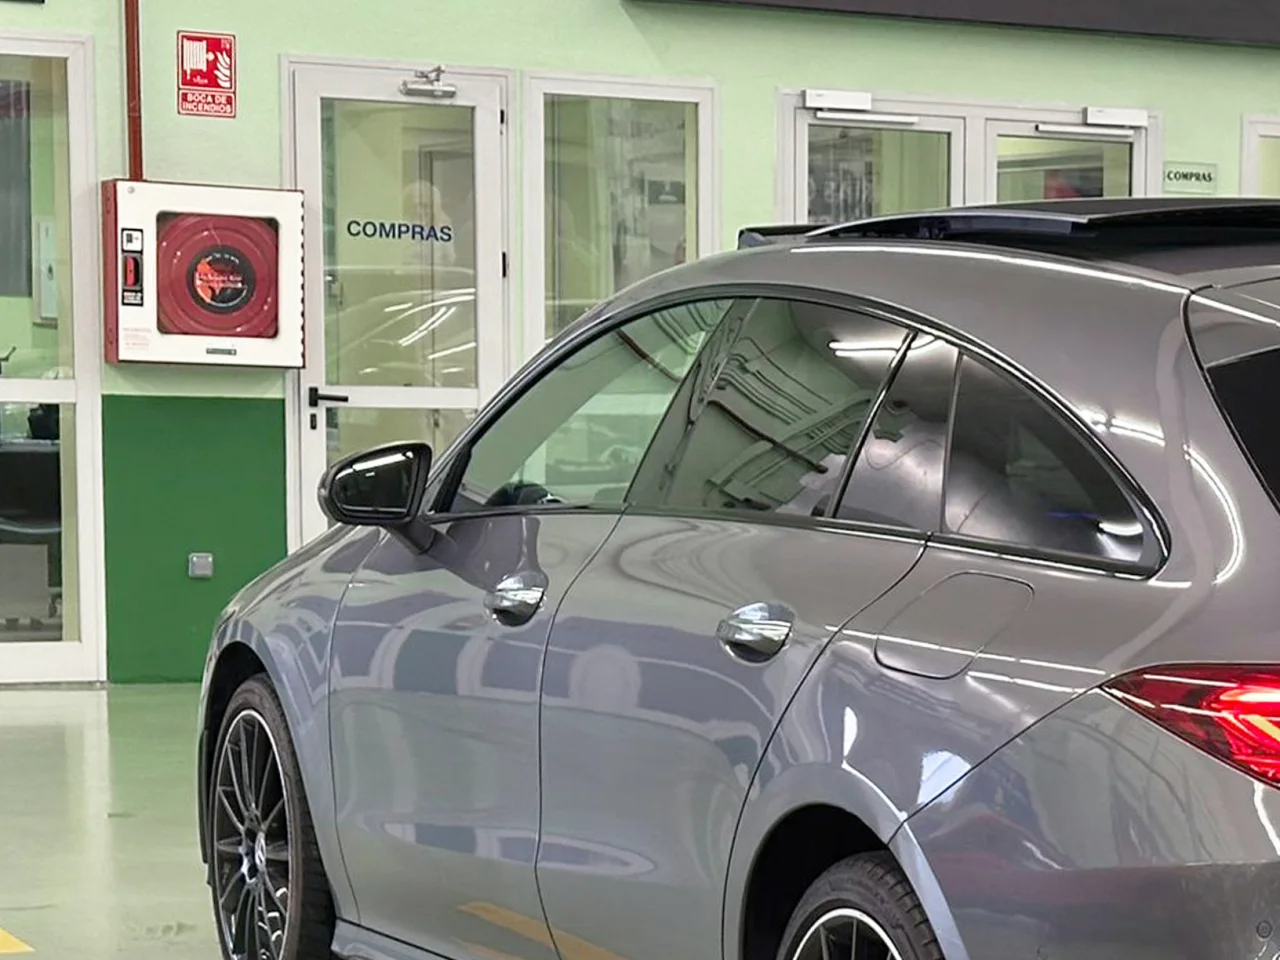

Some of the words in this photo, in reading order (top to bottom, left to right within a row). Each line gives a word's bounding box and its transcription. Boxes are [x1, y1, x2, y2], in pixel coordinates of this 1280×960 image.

[187, 93, 213, 103] BOCA
[214, 95, 227, 104] DE
[182, 101, 232, 113] INCENDIOS
[1166, 169, 1213, 183] COMPRAS
[347, 220, 453, 242] COMPRAS
